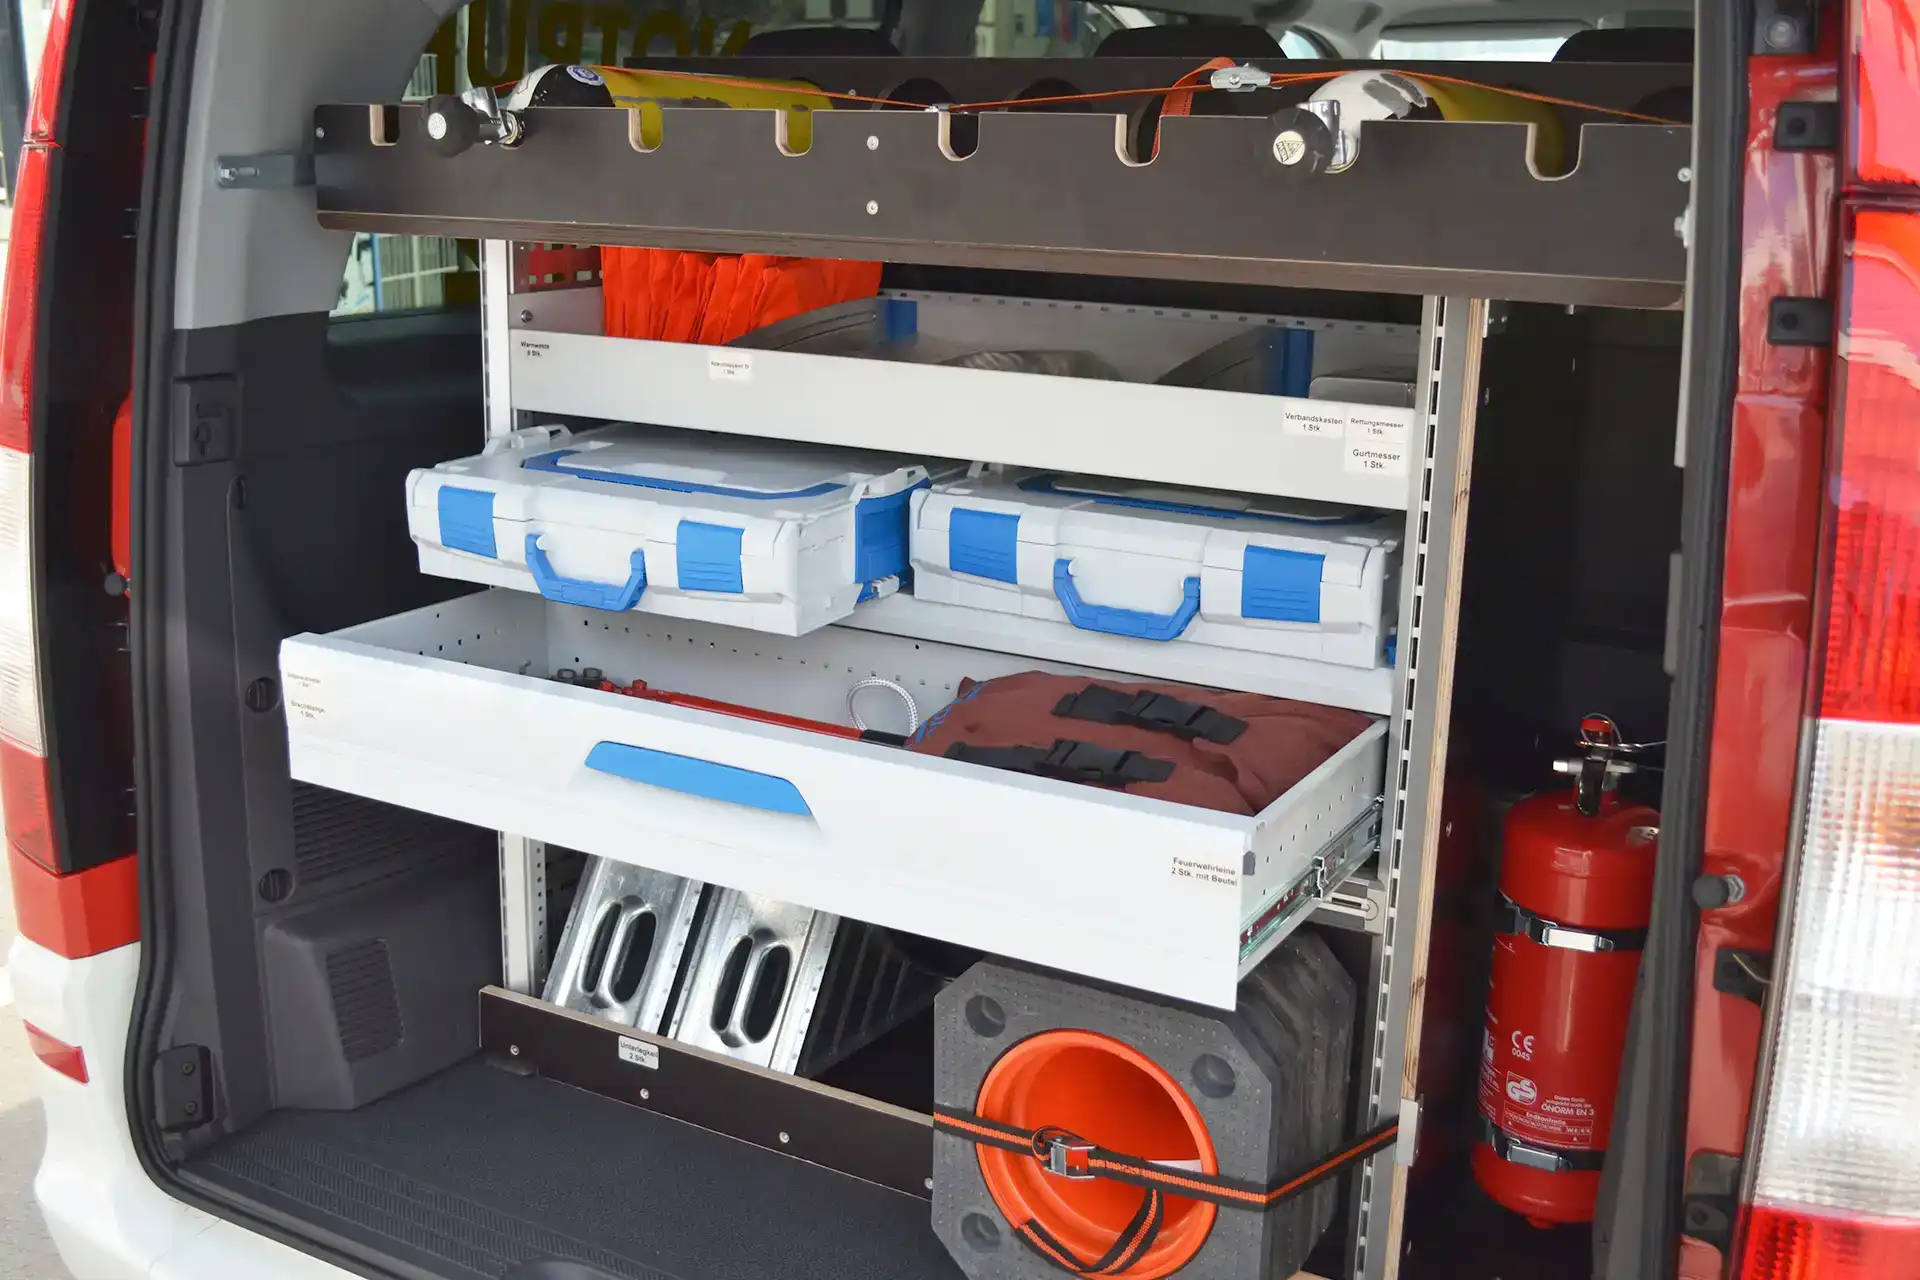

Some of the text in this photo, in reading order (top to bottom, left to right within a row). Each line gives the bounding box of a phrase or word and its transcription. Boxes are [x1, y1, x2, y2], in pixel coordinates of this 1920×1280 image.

[1285, 412, 1343, 425] Verbandskasten
[1350, 418, 1404, 428] Rettungsmesser
[1302, 424, 1307, 432] 1
[1352, 449, 1400, 461] Gurtmesser
[1363, 460, 1368, 468] 1
[1173, 857, 1236, 875] Feuerwehrleine
[1171, 867, 1238, 886] 2 Stk. mit Beutel
[629, 1052, 634, 1060] 2
[1511, 1048, 1531, 1061] 0045
[1576, 1108, 1587, 1116] EN
[1589, 1108, 1594, 1116] 3
